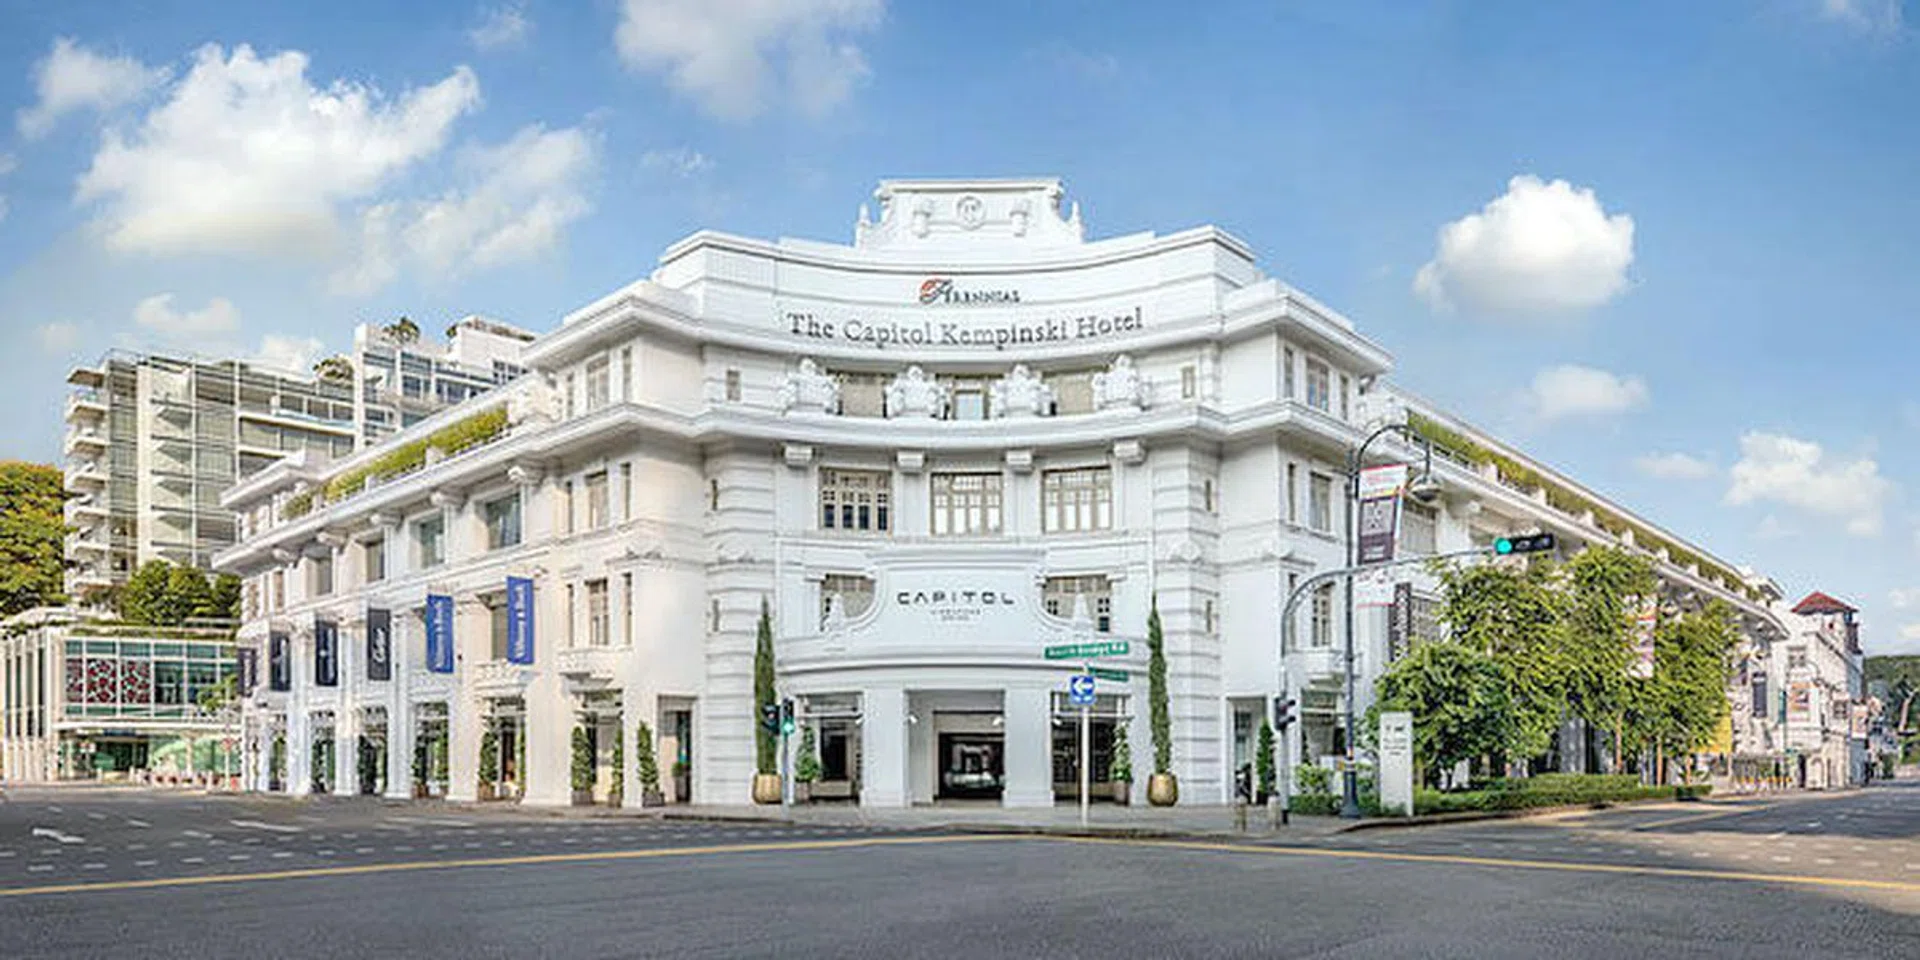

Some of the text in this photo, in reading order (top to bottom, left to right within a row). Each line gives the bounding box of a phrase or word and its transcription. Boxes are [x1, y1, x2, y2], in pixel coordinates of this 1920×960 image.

[787, 306, 1143, 350] The Capitol Kempinski Hotel
[897, 591, 1015, 605] CAPITOL
